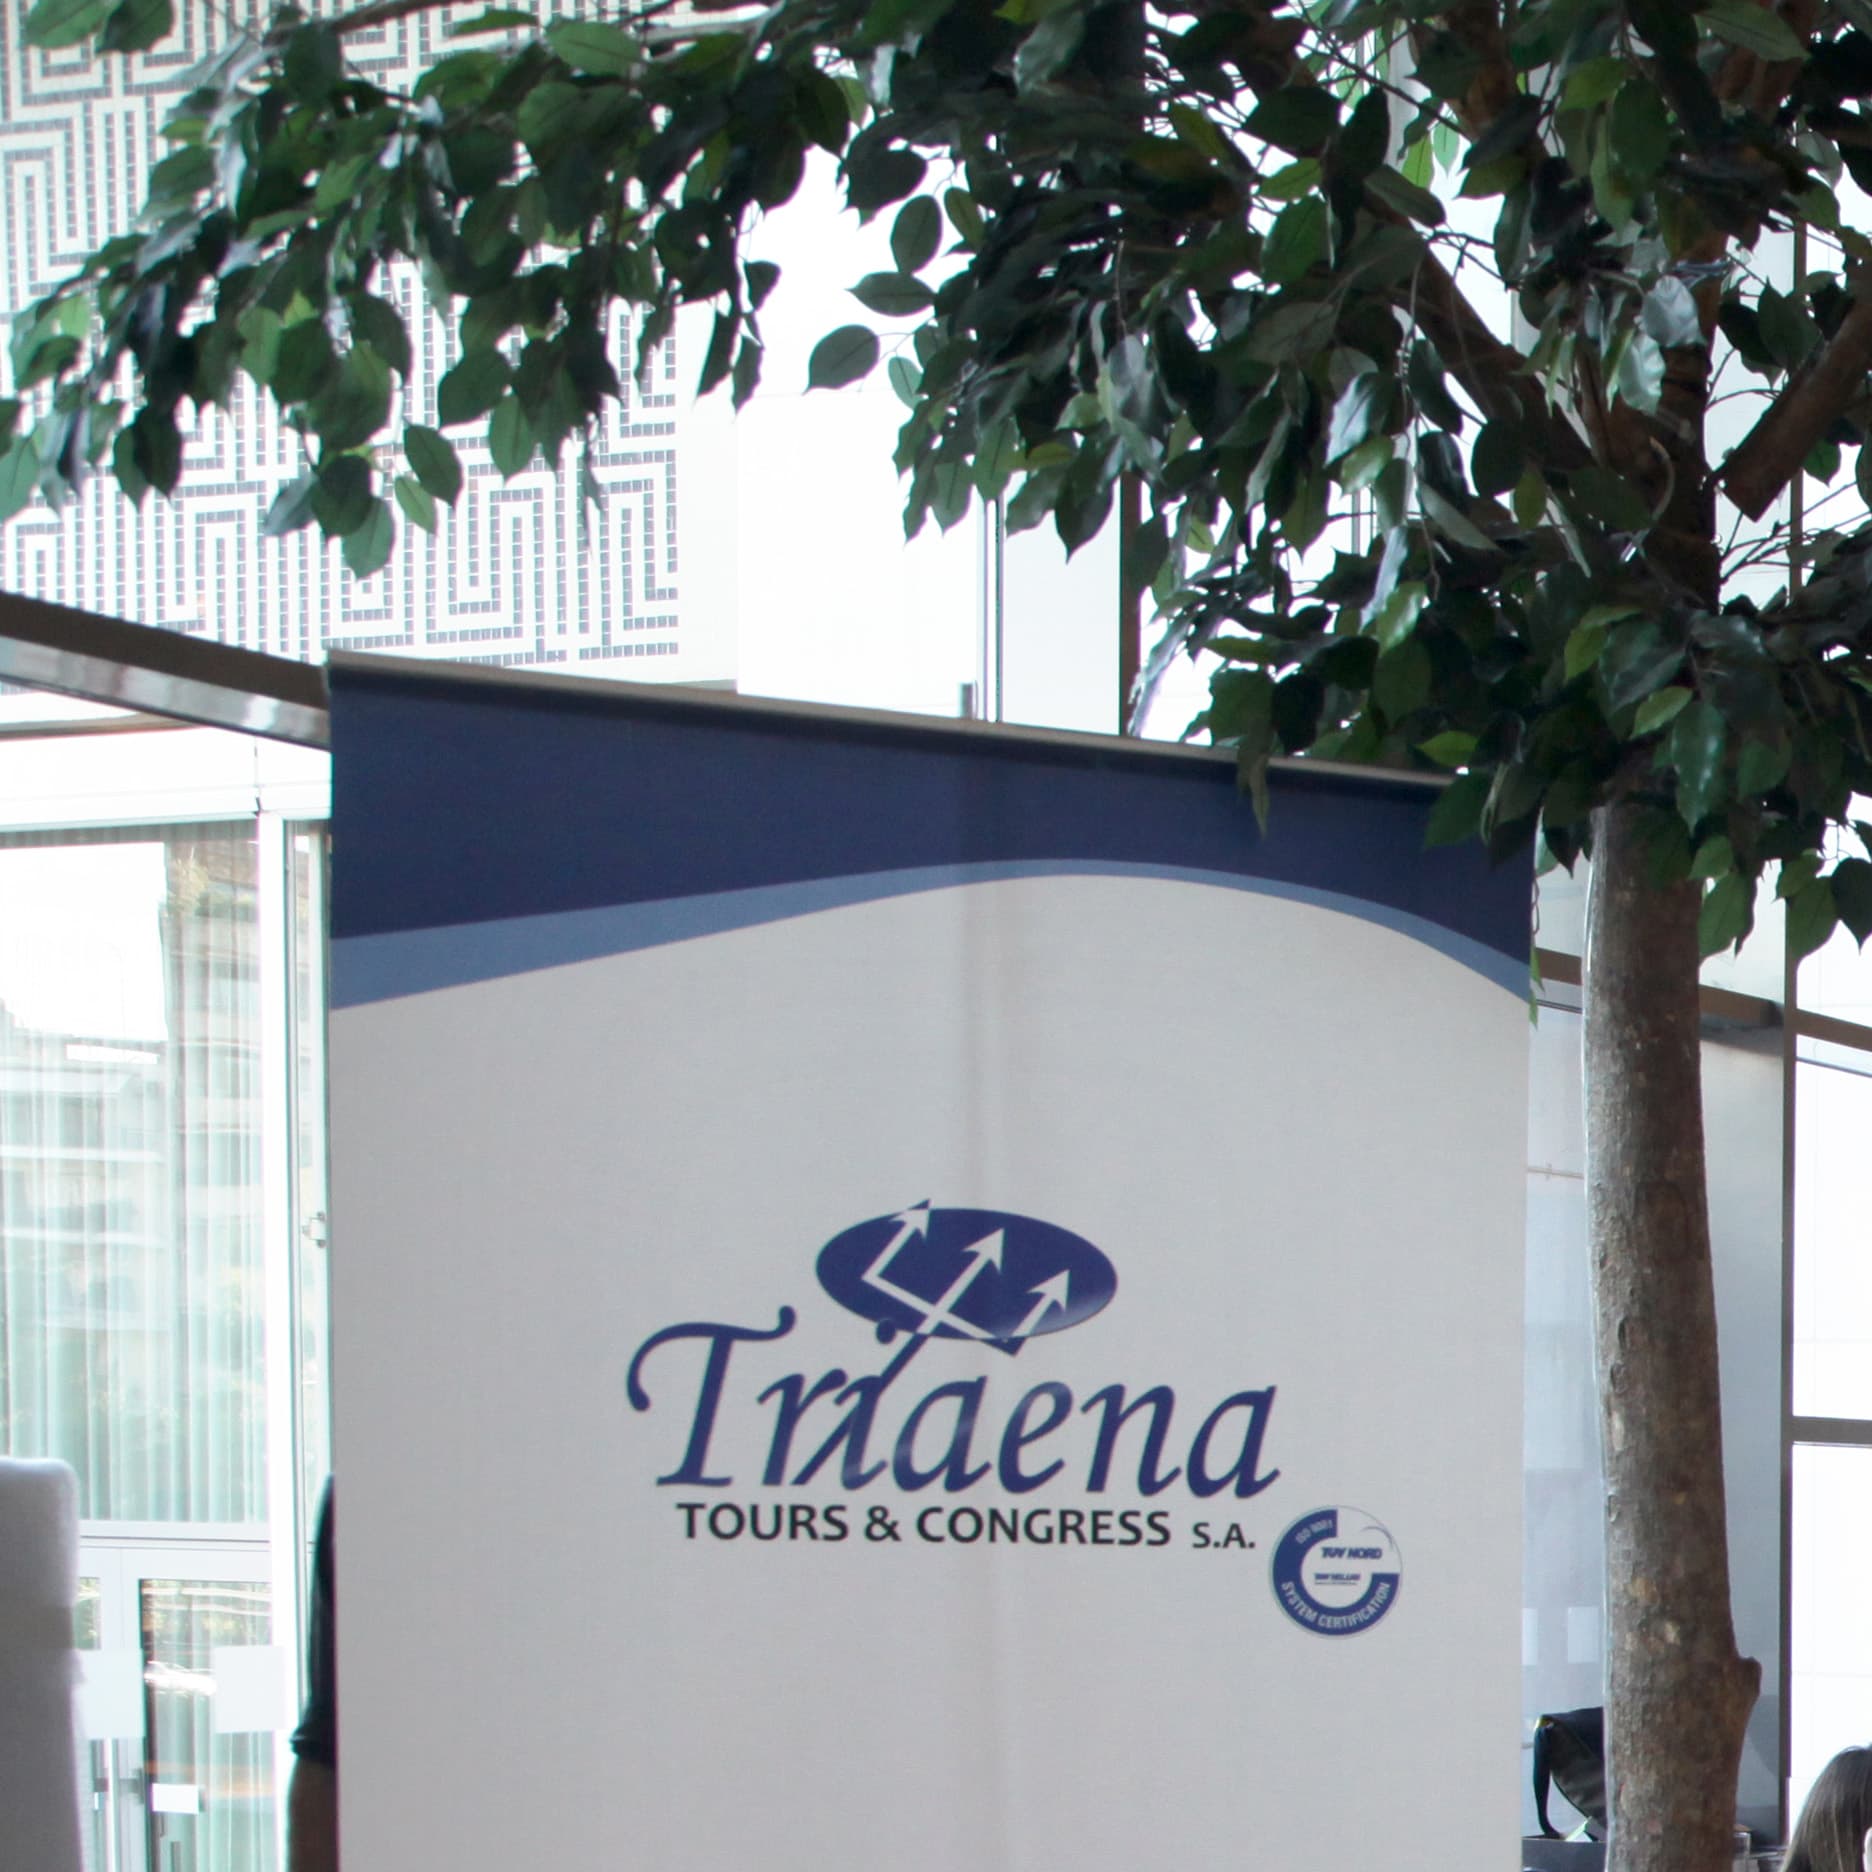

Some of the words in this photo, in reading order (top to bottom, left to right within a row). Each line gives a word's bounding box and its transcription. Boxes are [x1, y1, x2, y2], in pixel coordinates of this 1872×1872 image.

[626, 1304, 1281, 1499] Triaena
[676, 1502, 848, 1542] TOURS
[863, 1507, 902, 1543] &
[916, 1506, 1171, 1548] CONGRESS
[1191, 1520, 1256, 1550] S.A.
[1281, 1581, 1319, 1622] SYSTEM
[1317, 1582, 1391, 1628] CERTIFICATION
